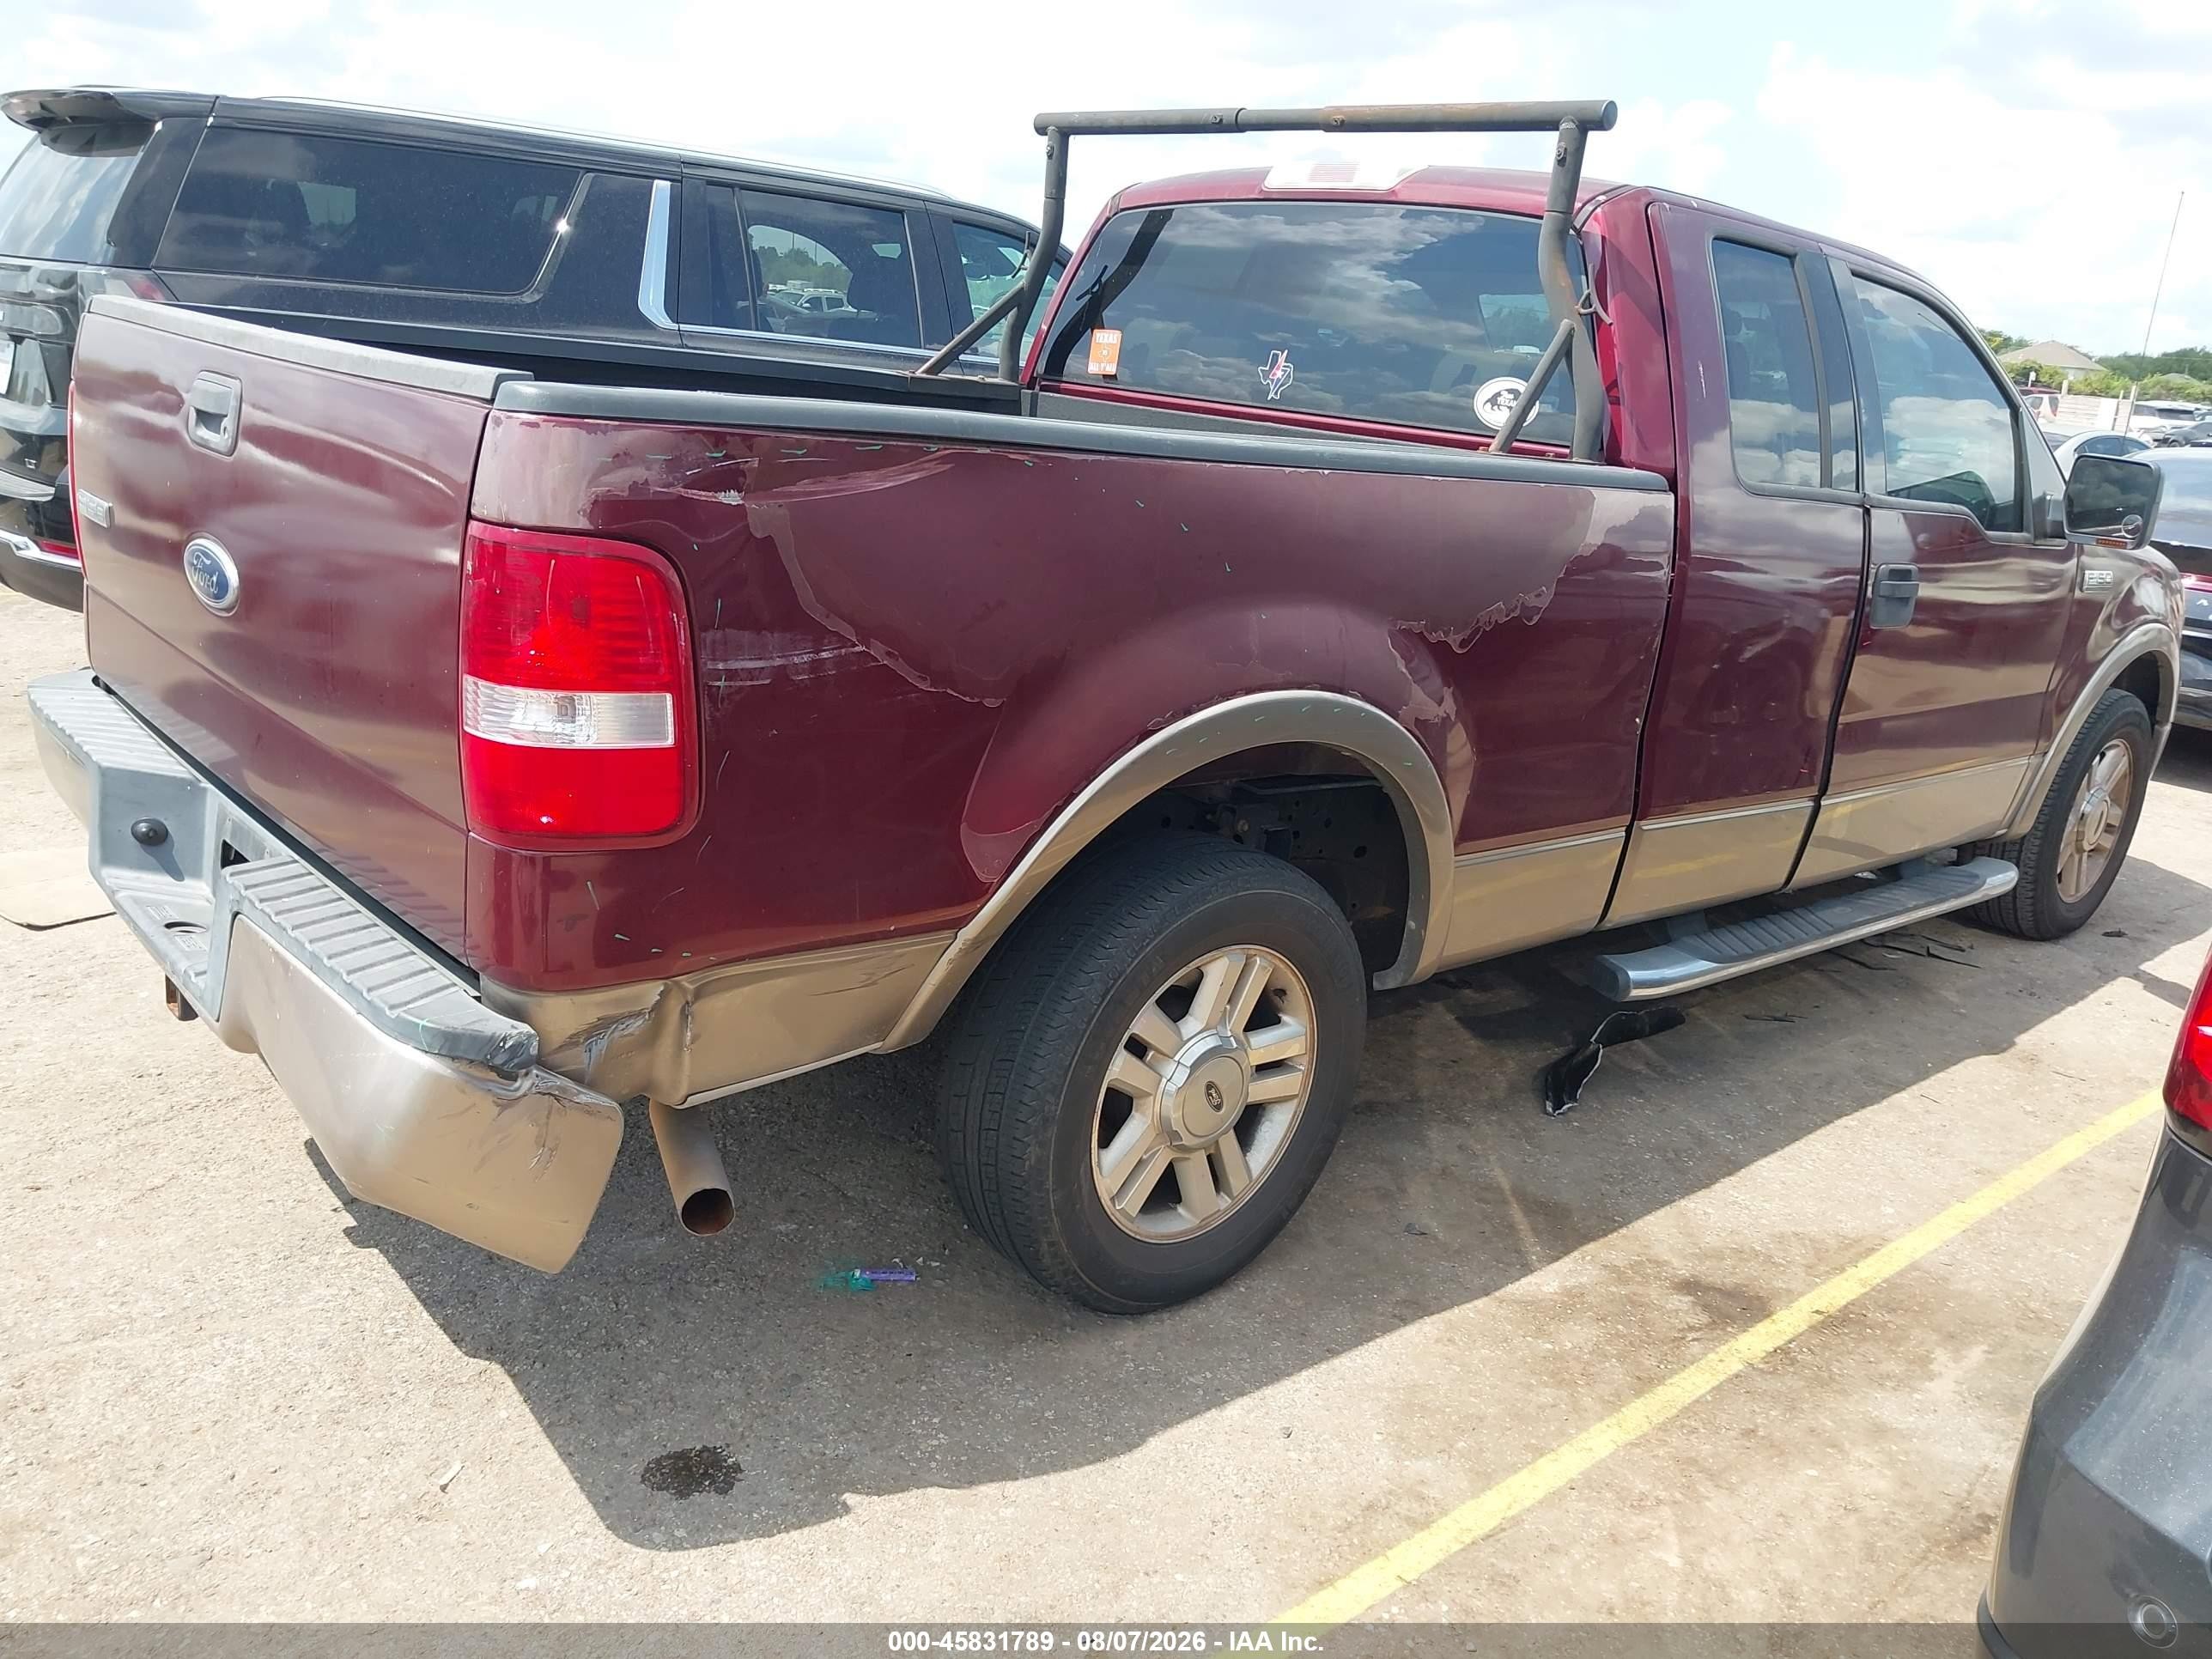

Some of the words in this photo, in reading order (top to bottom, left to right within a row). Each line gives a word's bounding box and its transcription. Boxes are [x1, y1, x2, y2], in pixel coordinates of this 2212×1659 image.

[1096, 332, 1118, 343] TEXAS
[192, 551, 220, 594] Ford
[1207, 1087, 1221, 1106] Ford
